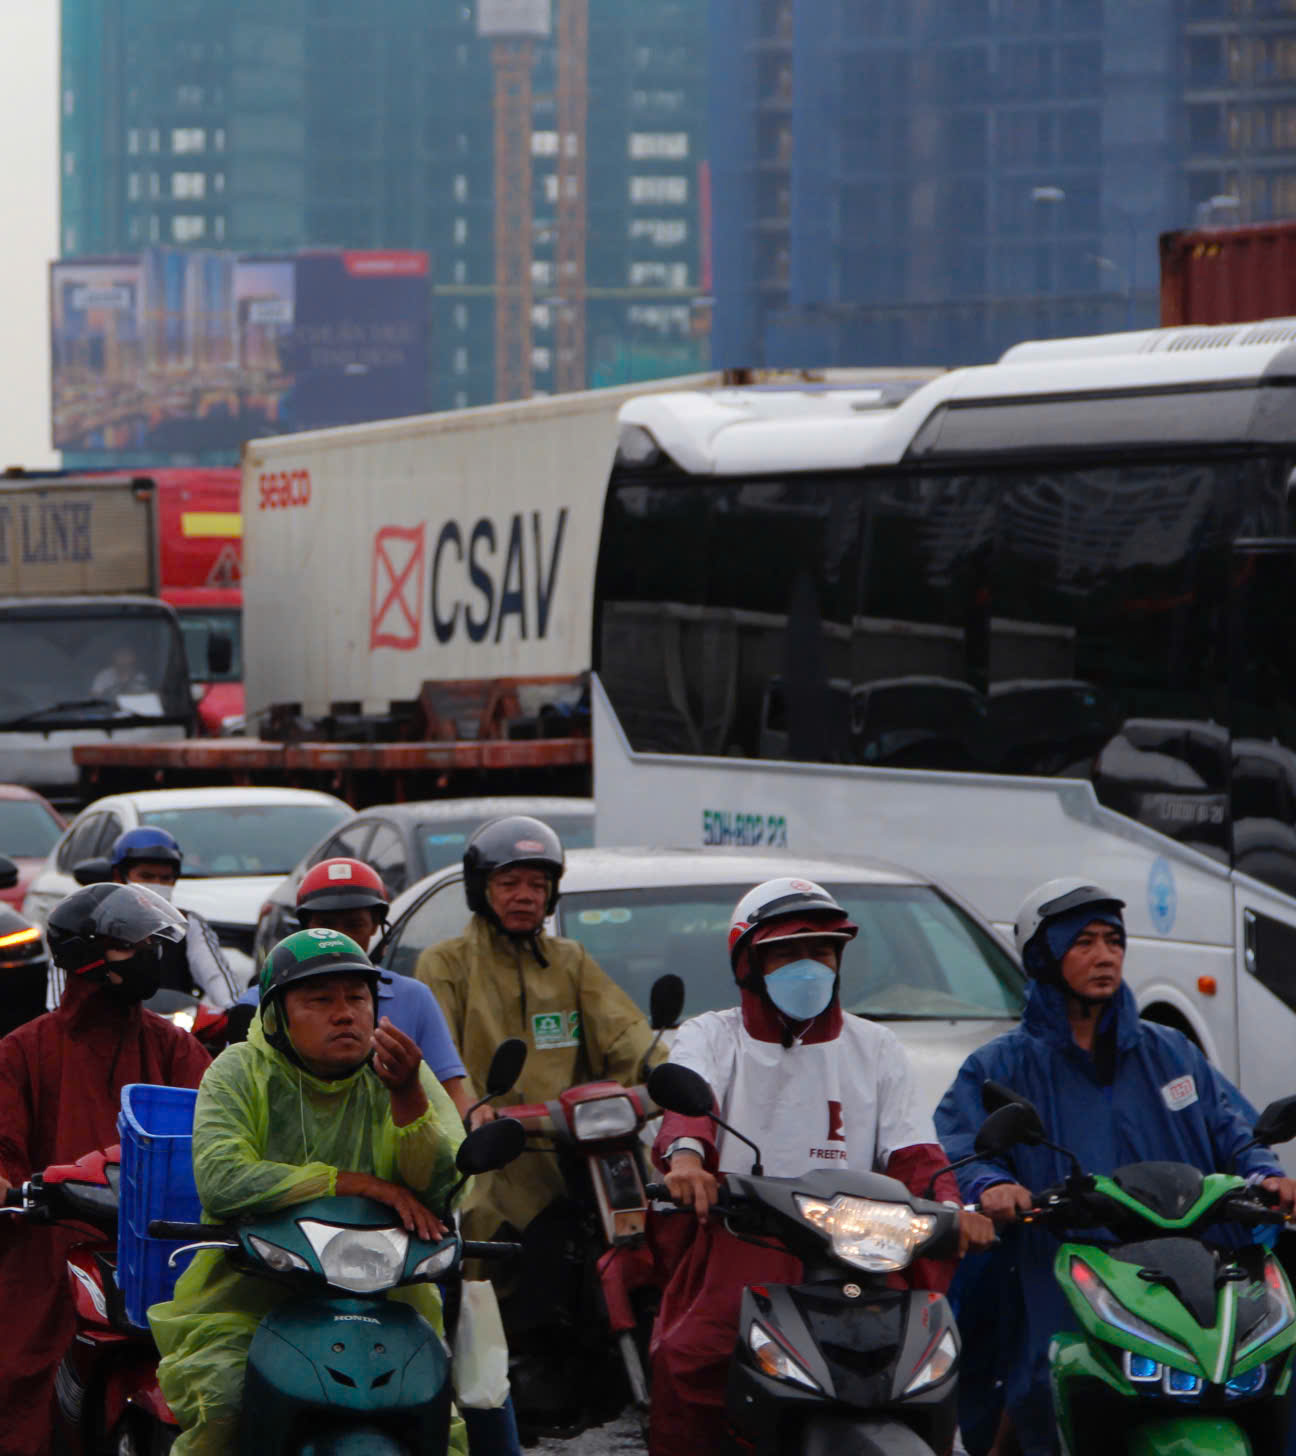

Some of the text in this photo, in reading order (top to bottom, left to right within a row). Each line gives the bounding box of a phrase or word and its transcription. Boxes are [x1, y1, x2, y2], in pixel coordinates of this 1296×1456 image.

[259, 468, 311, 508] seaco
[431, 507, 569, 645] CSAV
[334, 1315, 382, 1325] HONDA
